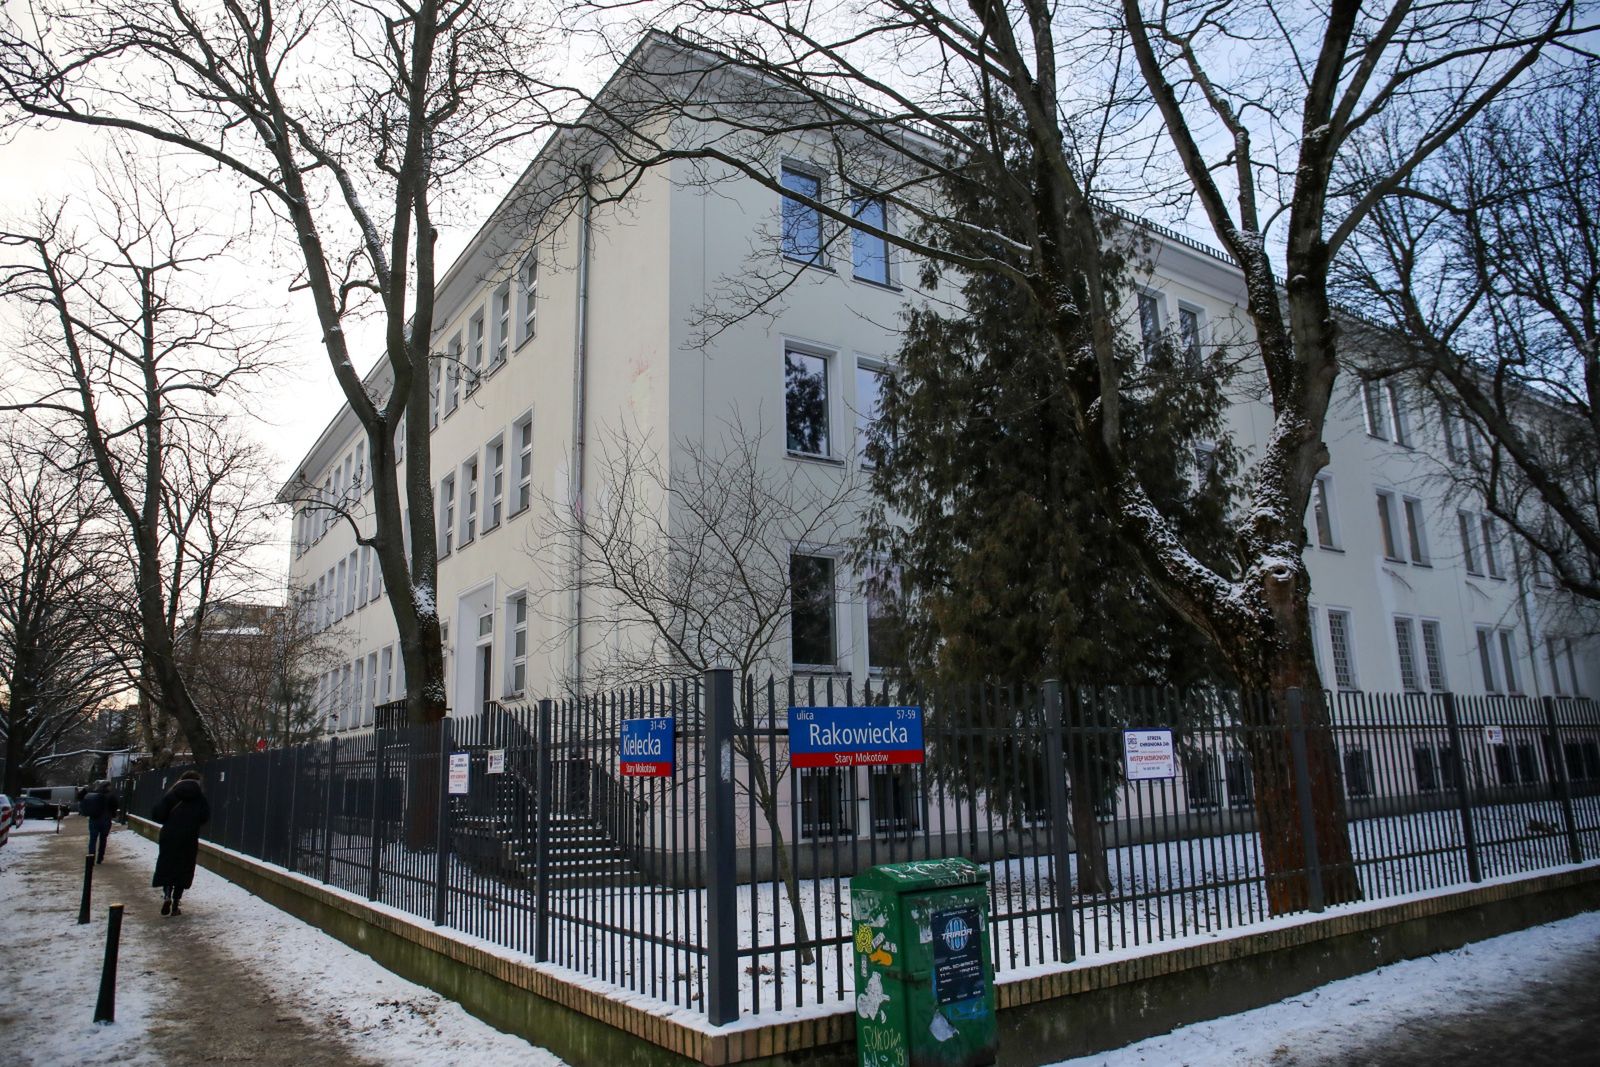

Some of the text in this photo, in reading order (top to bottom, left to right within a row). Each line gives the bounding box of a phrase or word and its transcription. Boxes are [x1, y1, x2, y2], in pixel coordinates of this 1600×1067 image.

[796, 709, 916, 720] ulica 57-59
[650, 720, 667, 730] 31-45
[809, 720, 908, 746] Rakowiecka
[623, 732, 661, 755] Kielecka
[834, 751, 889, 765] Stary Mokotów
[625, 763, 657, 775] Stary Mokotów
